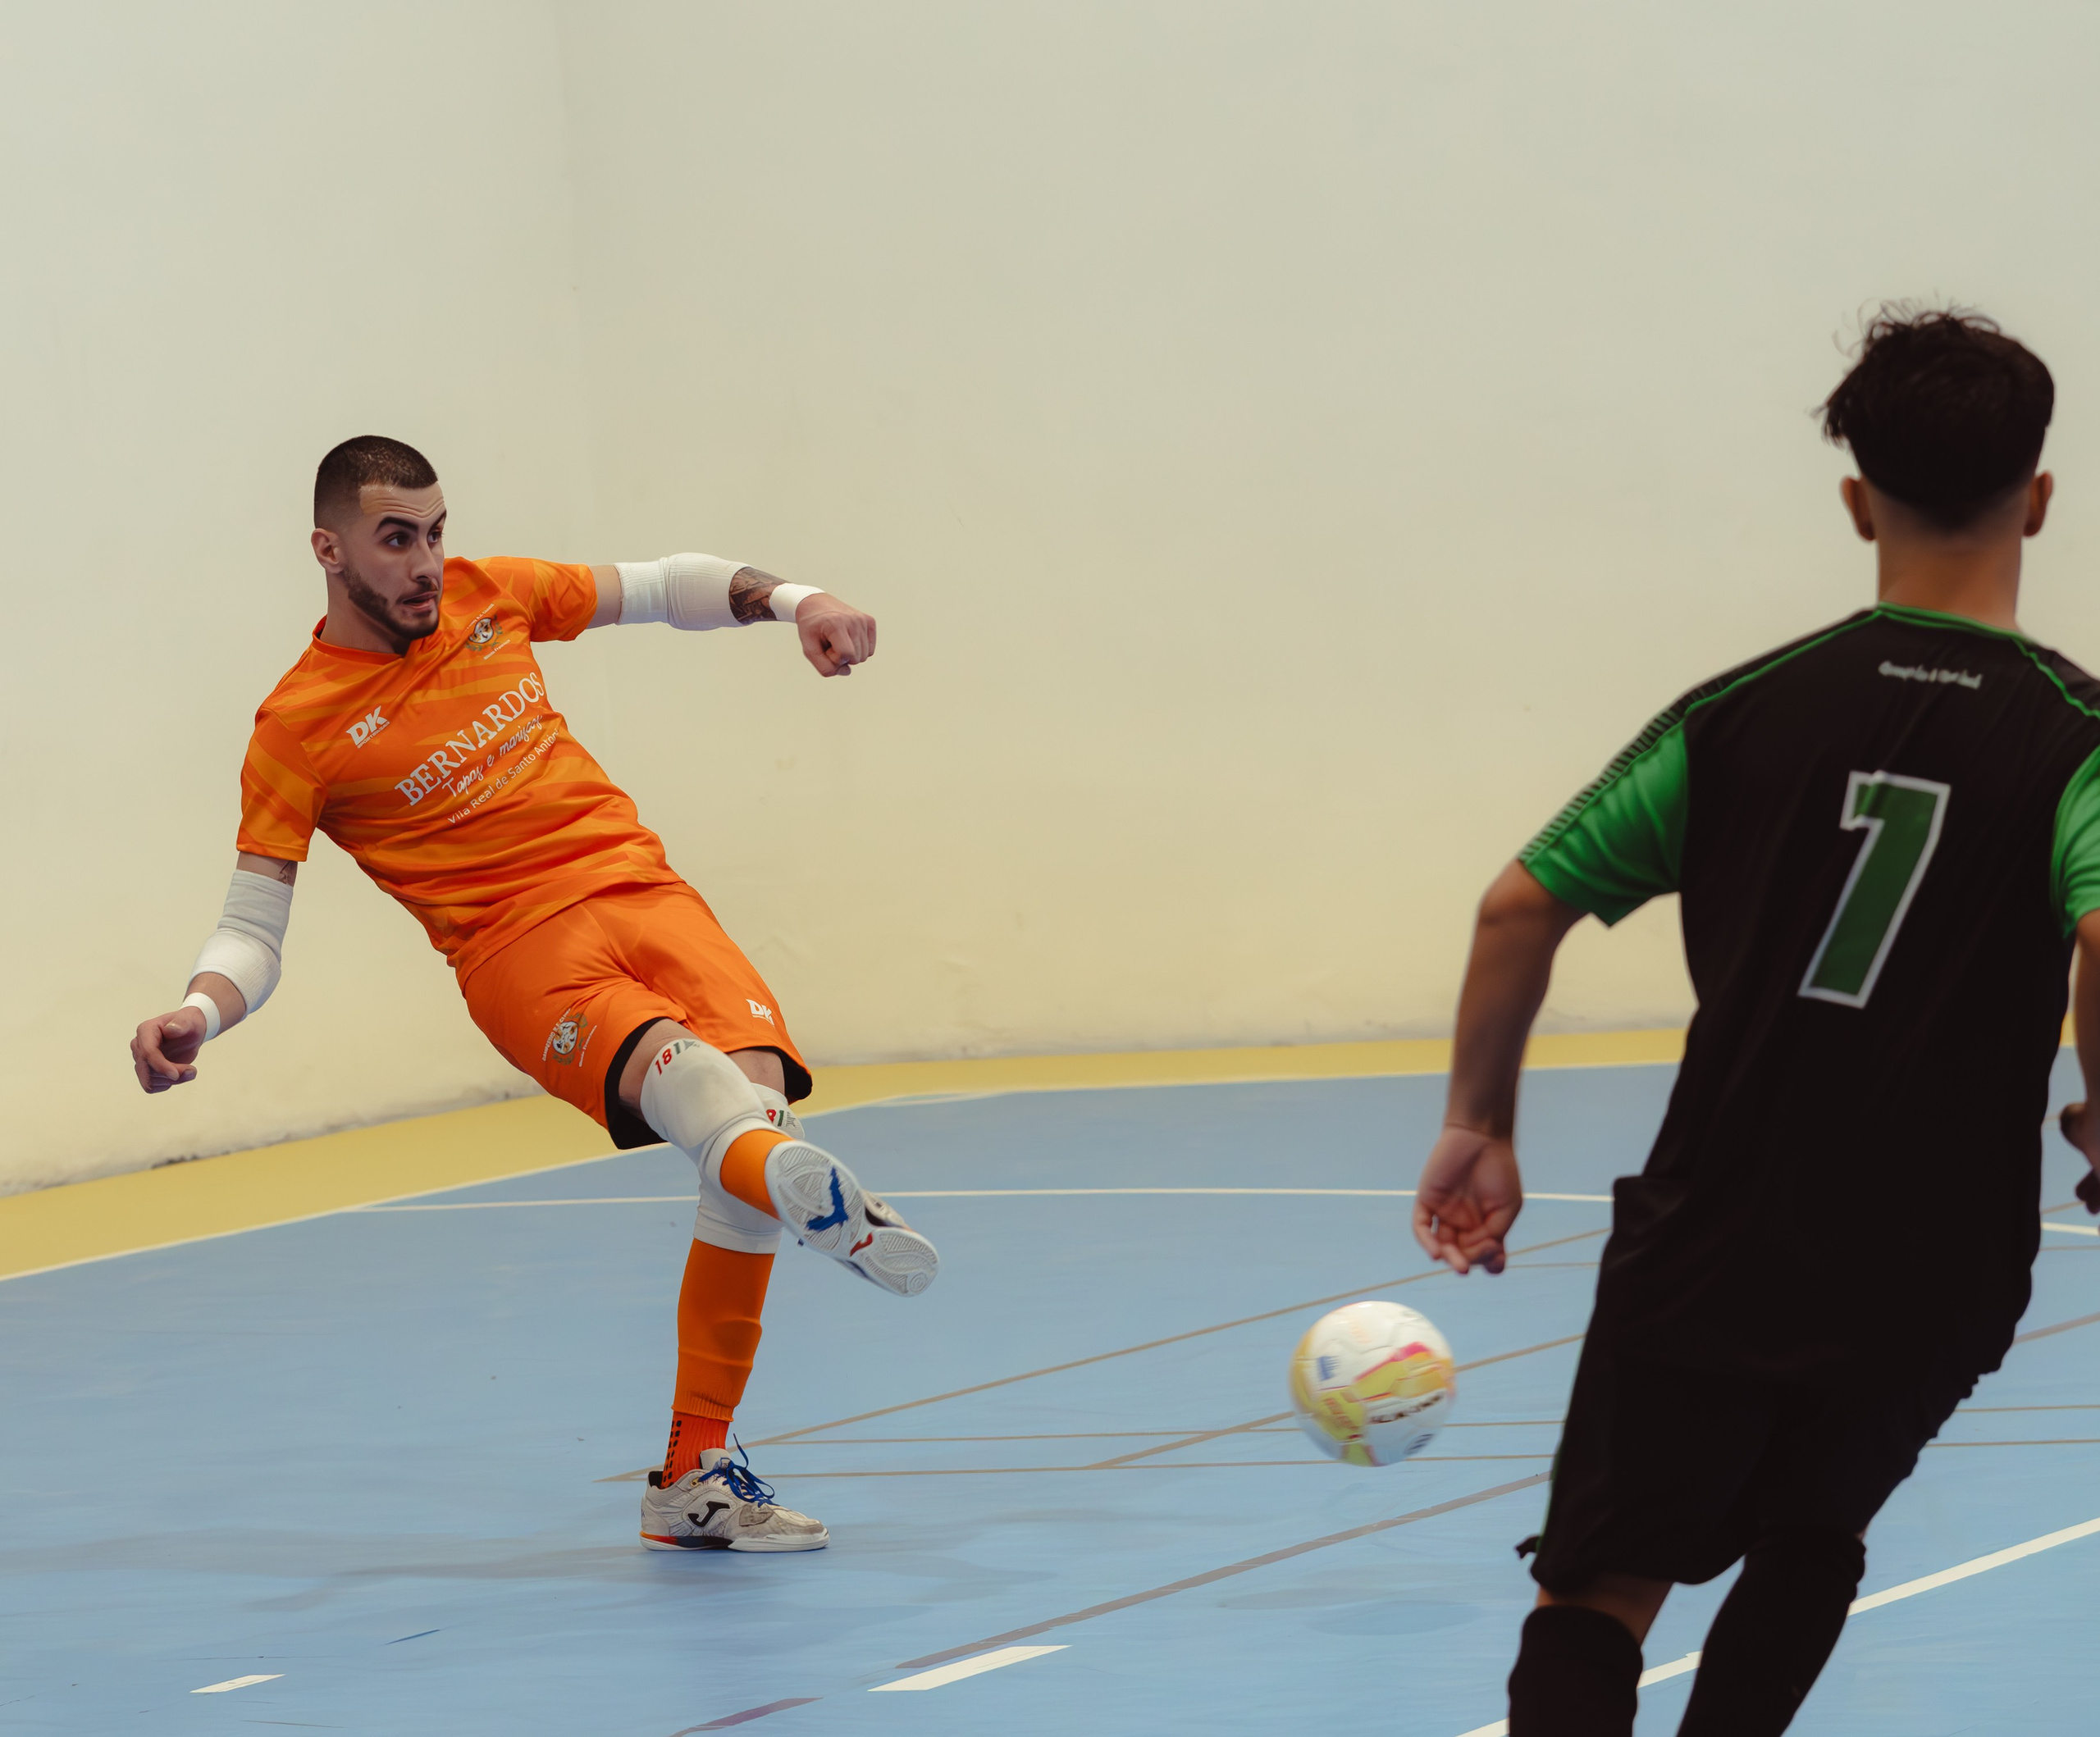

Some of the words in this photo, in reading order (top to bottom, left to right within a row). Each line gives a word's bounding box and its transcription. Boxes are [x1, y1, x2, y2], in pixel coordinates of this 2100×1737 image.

[345, 705, 388, 745] DK
[395, 672, 546, 806] BERNARDOS
[442, 765, 483, 798] Tapas
[486, 755, 495, 768] e
[447, 808, 471, 824] Vila
[470, 786, 495, 809] Real
[495, 776, 509, 790] de
[509, 752, 536, 777] Santo
